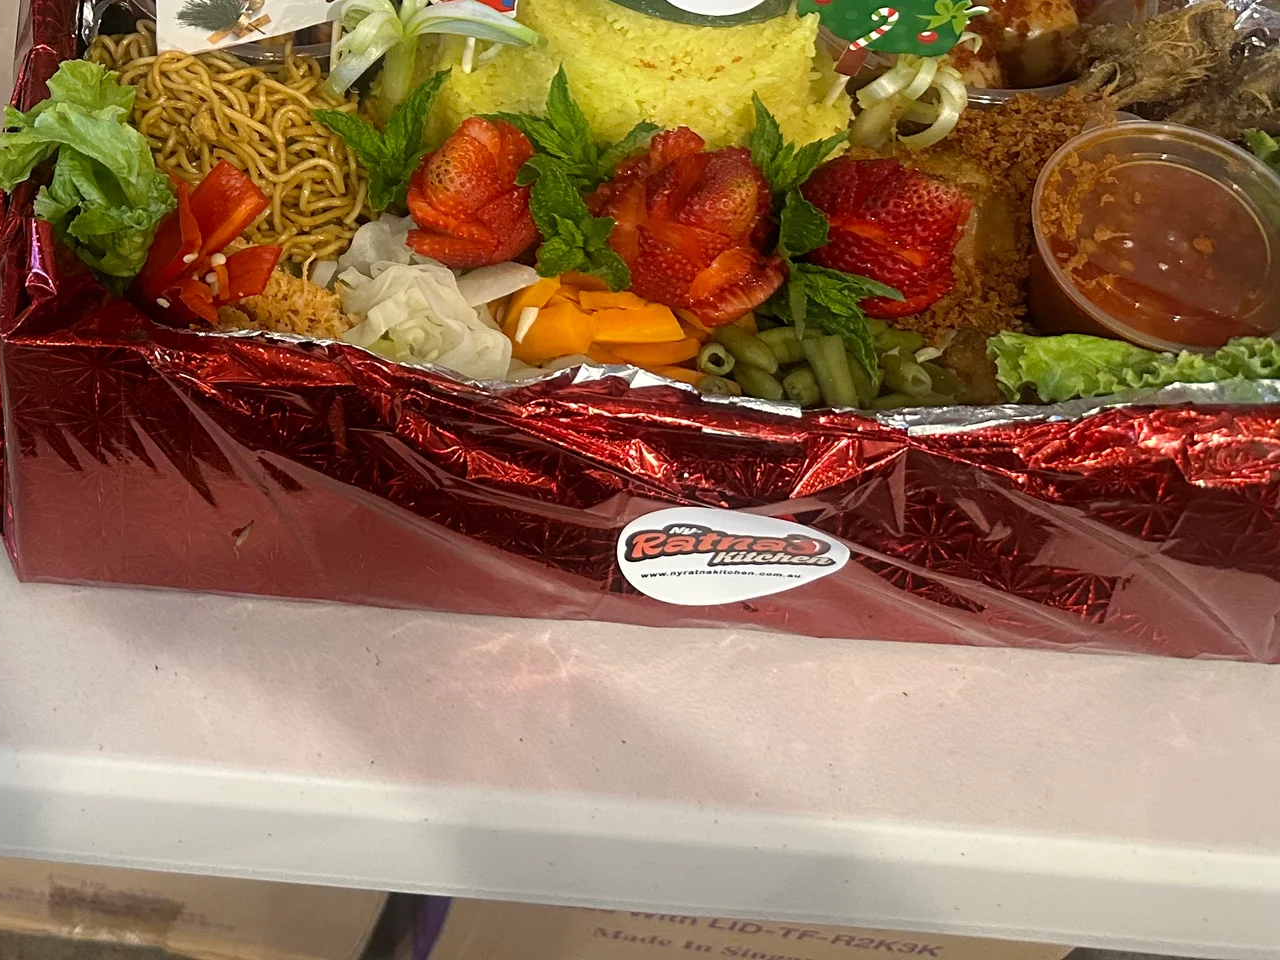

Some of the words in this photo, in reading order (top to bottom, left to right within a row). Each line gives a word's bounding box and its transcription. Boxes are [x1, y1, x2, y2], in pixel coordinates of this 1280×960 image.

[630, 533, 786, 559] Ratna
[713, 551, 835, 567] Kitchen
[640, 568, 801, 579] www.nyratnakitchen.com.au
[592, 926, 672, 947] Made
